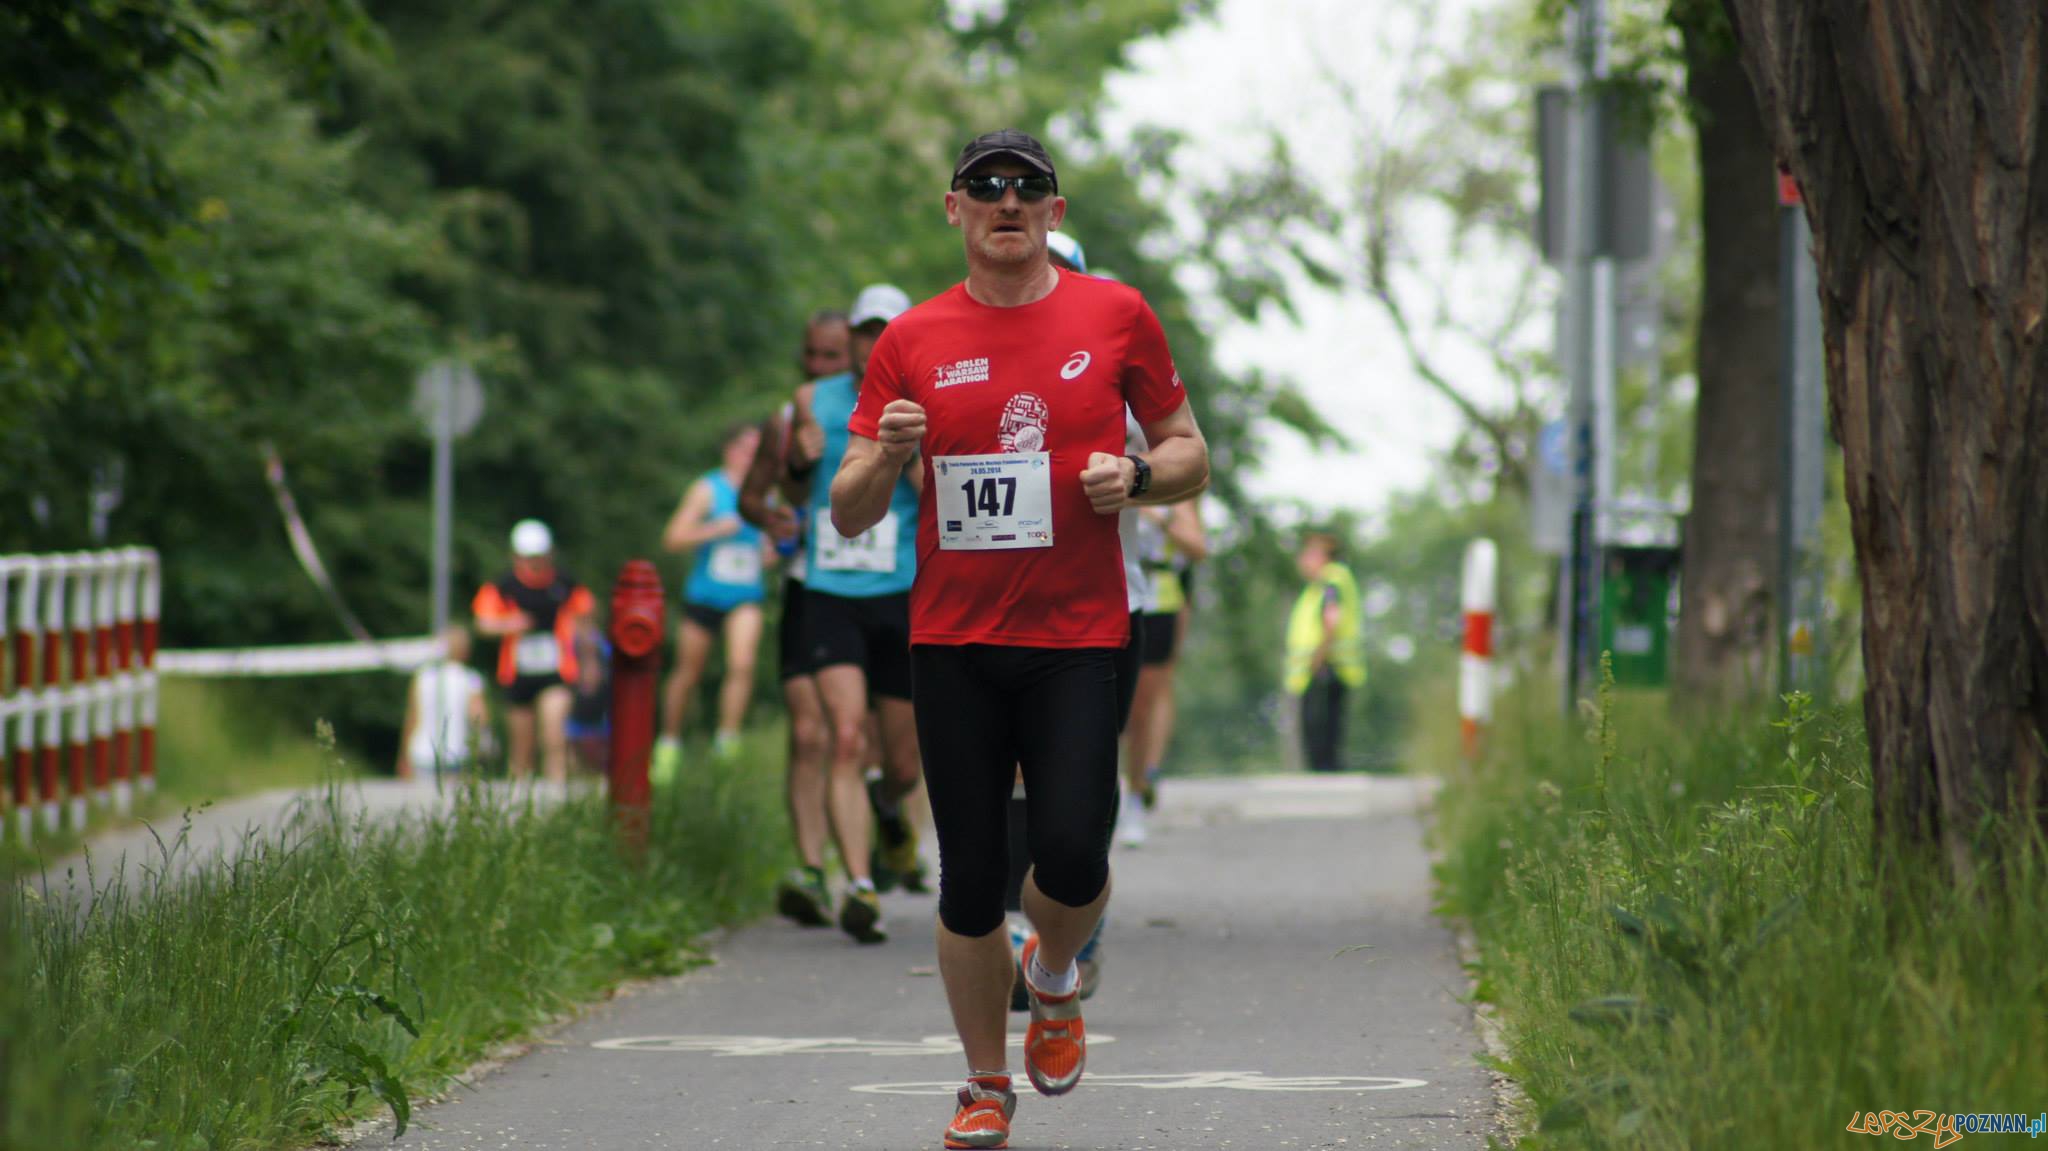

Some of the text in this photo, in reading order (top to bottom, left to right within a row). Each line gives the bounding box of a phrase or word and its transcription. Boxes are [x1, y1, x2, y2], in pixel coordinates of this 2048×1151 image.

[955, 357, 989, 369] ORLEN
[946, 365, 989, 378] WARSAW
[934, 373, 989, 389] MARATHON
[961, 477, 1016, 518] 147
